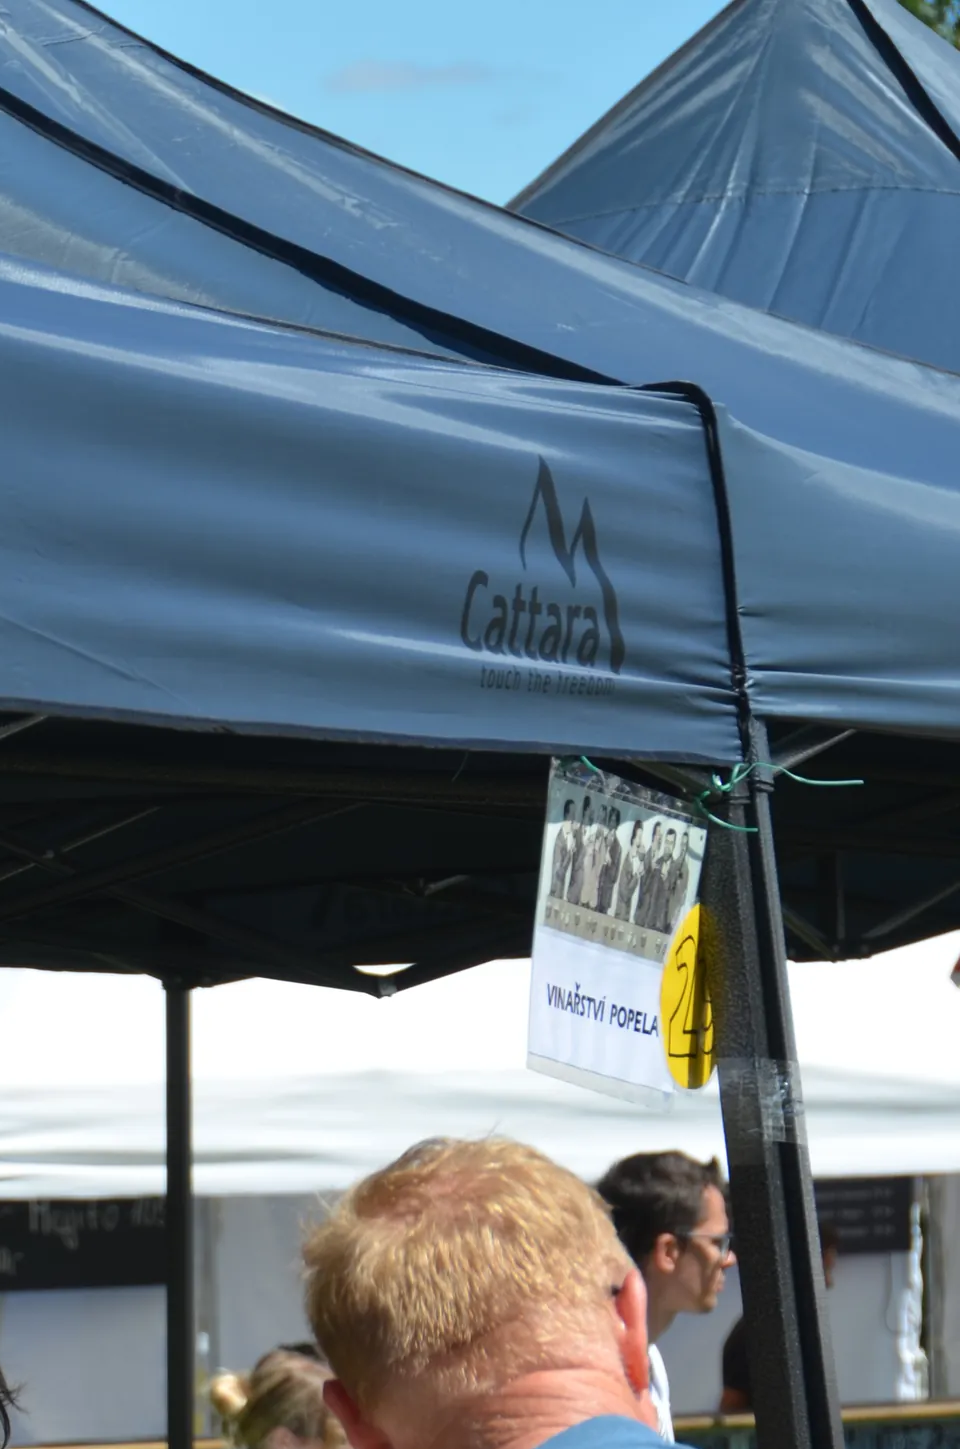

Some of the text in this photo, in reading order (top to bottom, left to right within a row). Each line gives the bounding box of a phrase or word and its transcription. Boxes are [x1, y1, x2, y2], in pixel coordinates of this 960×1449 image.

[460, 569, 601, 668] Cattara
[480, 664, 522, 692] touch
[527, 667, 552, 694] the
[546, 981, 660, 1038] VINAŘSTVÍ POPELA
